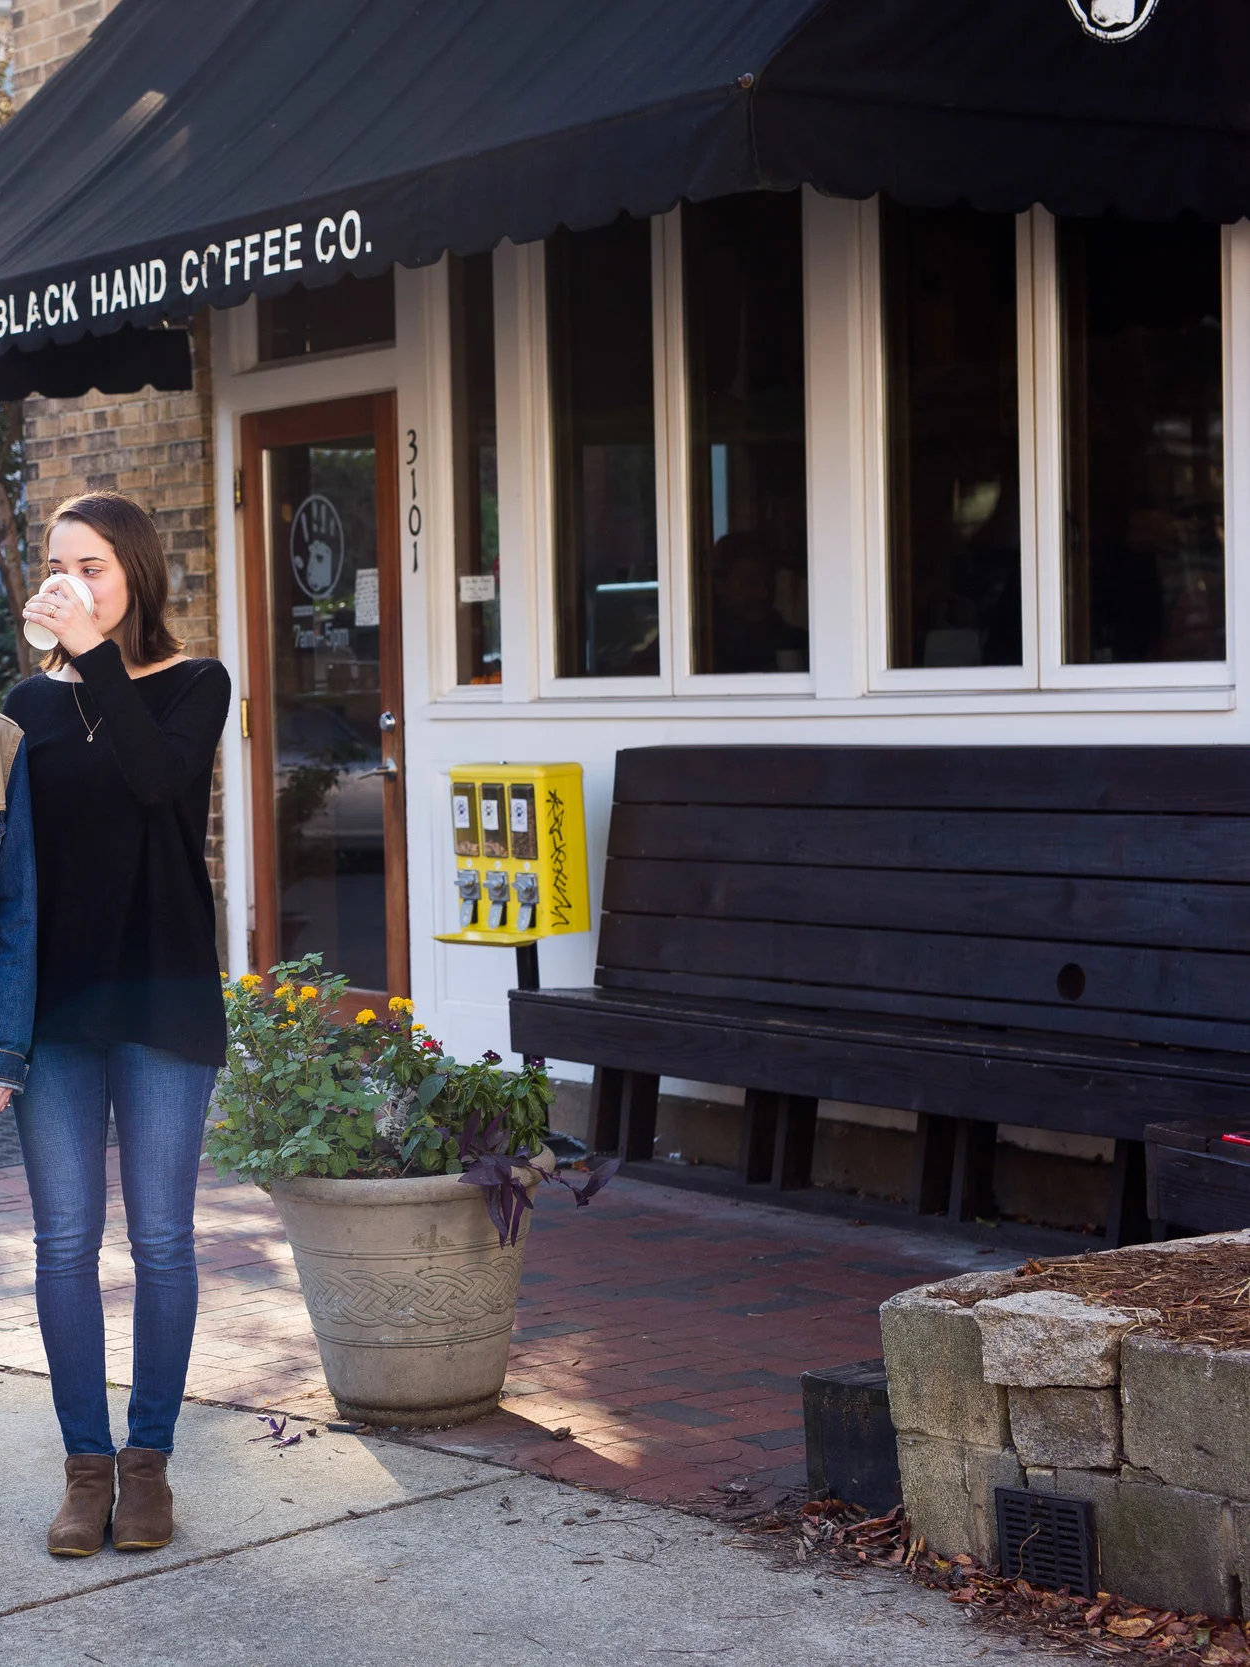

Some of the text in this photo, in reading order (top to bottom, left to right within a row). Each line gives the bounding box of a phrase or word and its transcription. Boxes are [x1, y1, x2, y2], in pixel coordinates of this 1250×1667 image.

[90, 258, 167, 317] HAND
[314, 209, 372, 264] CO.
[406, 429, 422, 573] 3101
